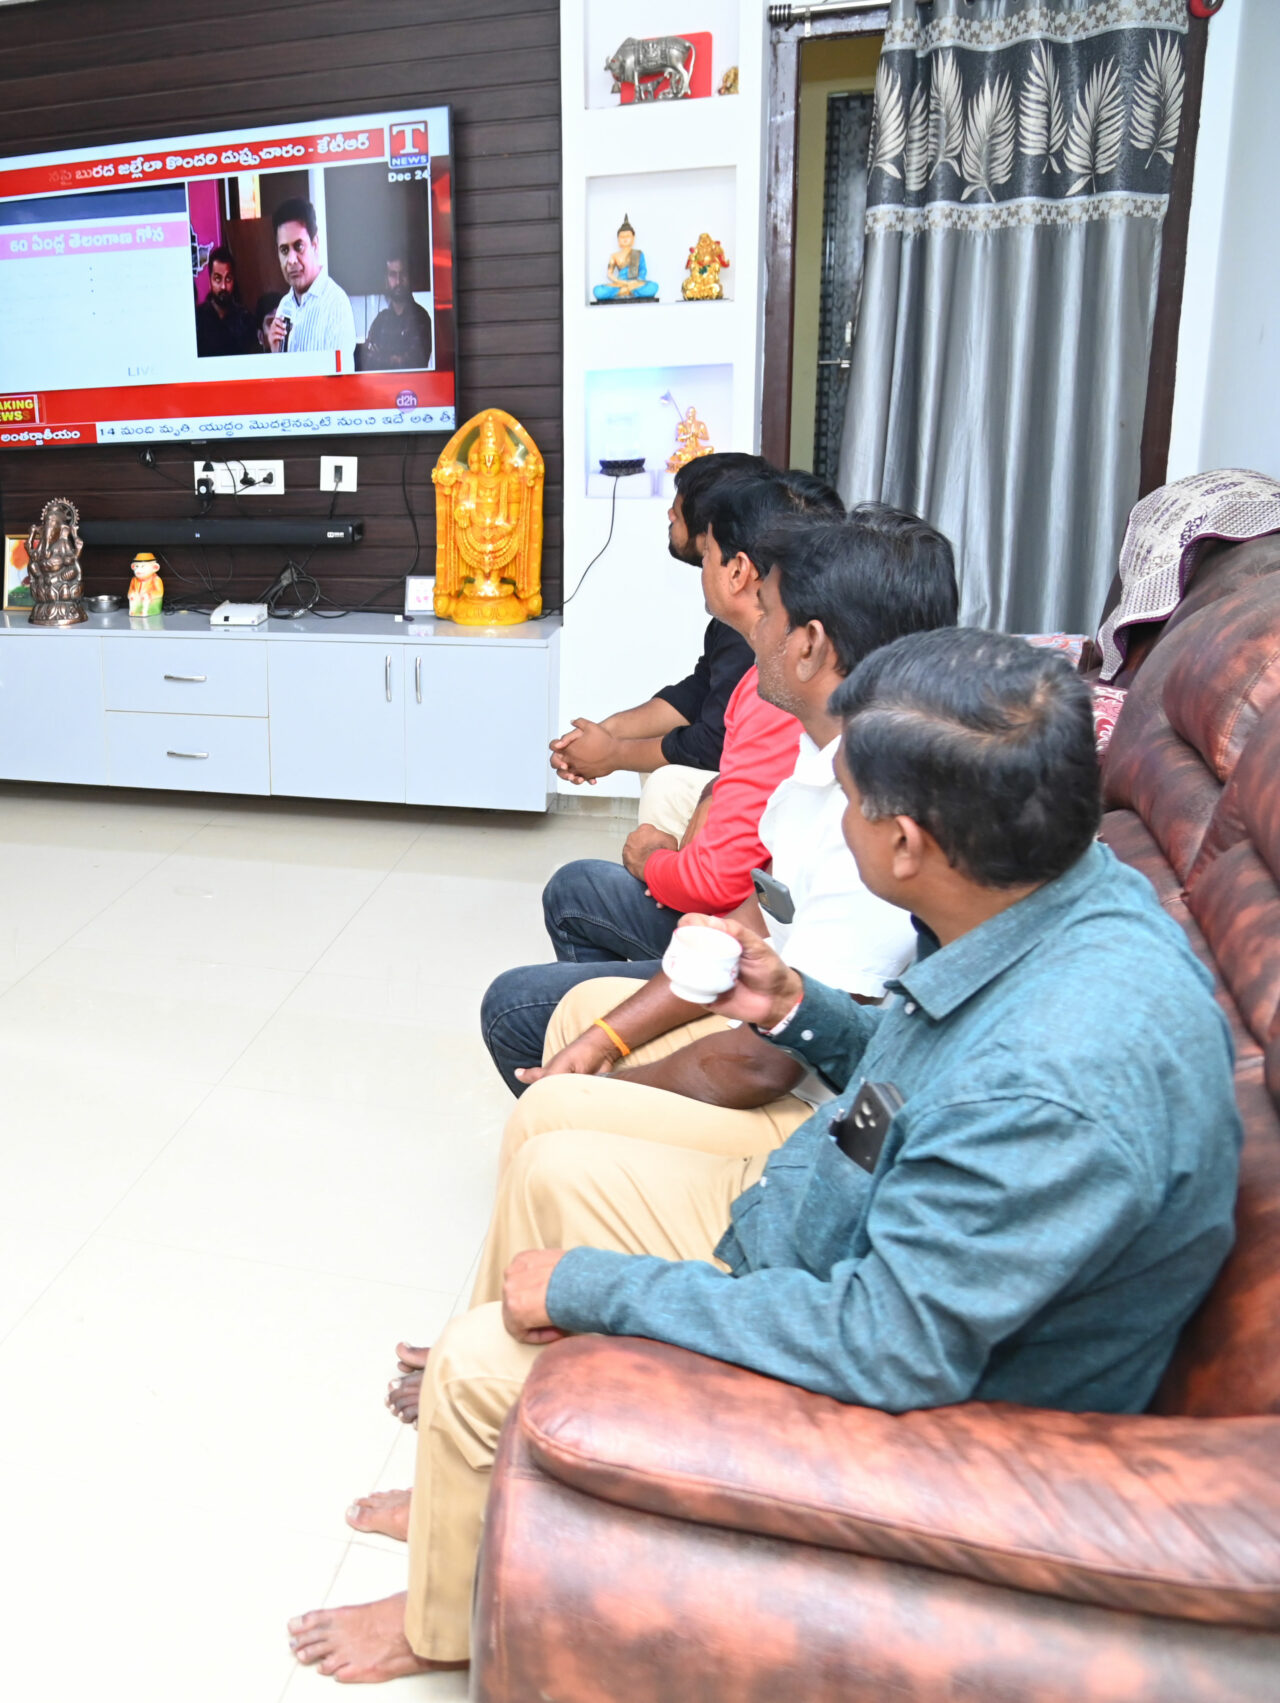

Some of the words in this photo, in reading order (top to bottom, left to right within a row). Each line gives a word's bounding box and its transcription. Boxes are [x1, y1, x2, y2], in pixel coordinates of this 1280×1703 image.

[391, 123, 426, 155] T
[75, 163, 115, 180] బురద
[166, 152, 218, 171] కొందరి
[316, 132, 370, 154] కేటీఆర్
[391, 155, 427, 167] NEWS
[387, 171, 412, 183] Dec
[414, 169, 430, 181] 24
[9, 239, 28, 252] 60
[395, 394, 418, 407] d2h
[100, 427, 116, 437] 14
[120, 424, 154, 436] మంది
[198, 421, 243, 437] యుద్ధం
[248, 415, 332, 433] మొదలైనప్పటి
[337, 415, 377, 427] నుంచి
[382, 412, 405, 425] ఇదే
[410, 413, 434, 424] అతి
